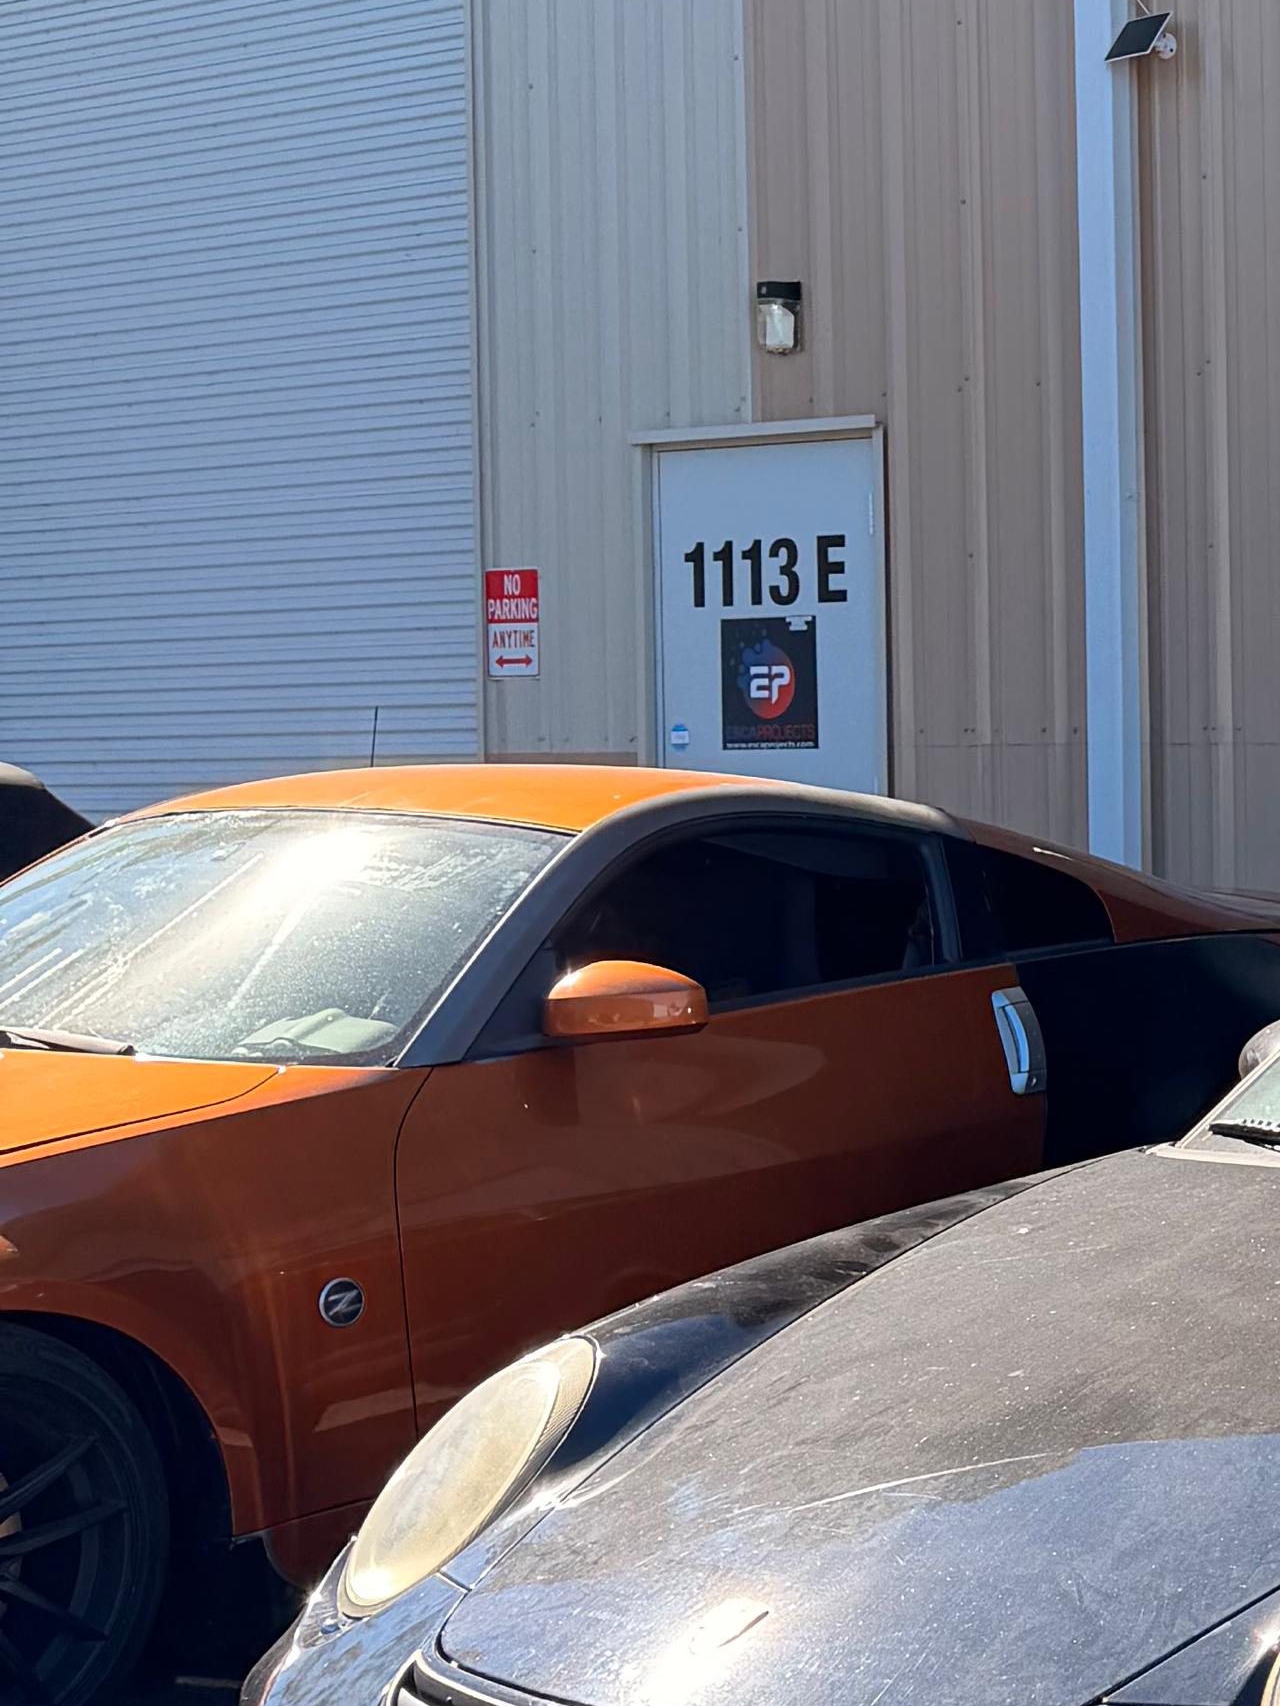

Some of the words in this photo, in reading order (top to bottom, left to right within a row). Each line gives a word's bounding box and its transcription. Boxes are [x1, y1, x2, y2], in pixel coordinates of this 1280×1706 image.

[684, 538, 800, 607] 1113
[816, 535, 847, 603] E
[503, 574, 521, 595] NO
[488, 597, 537, 620] PARKING
[492, 630, 535, 648] ANYTIME
[750, 665, 790, 704] EP
